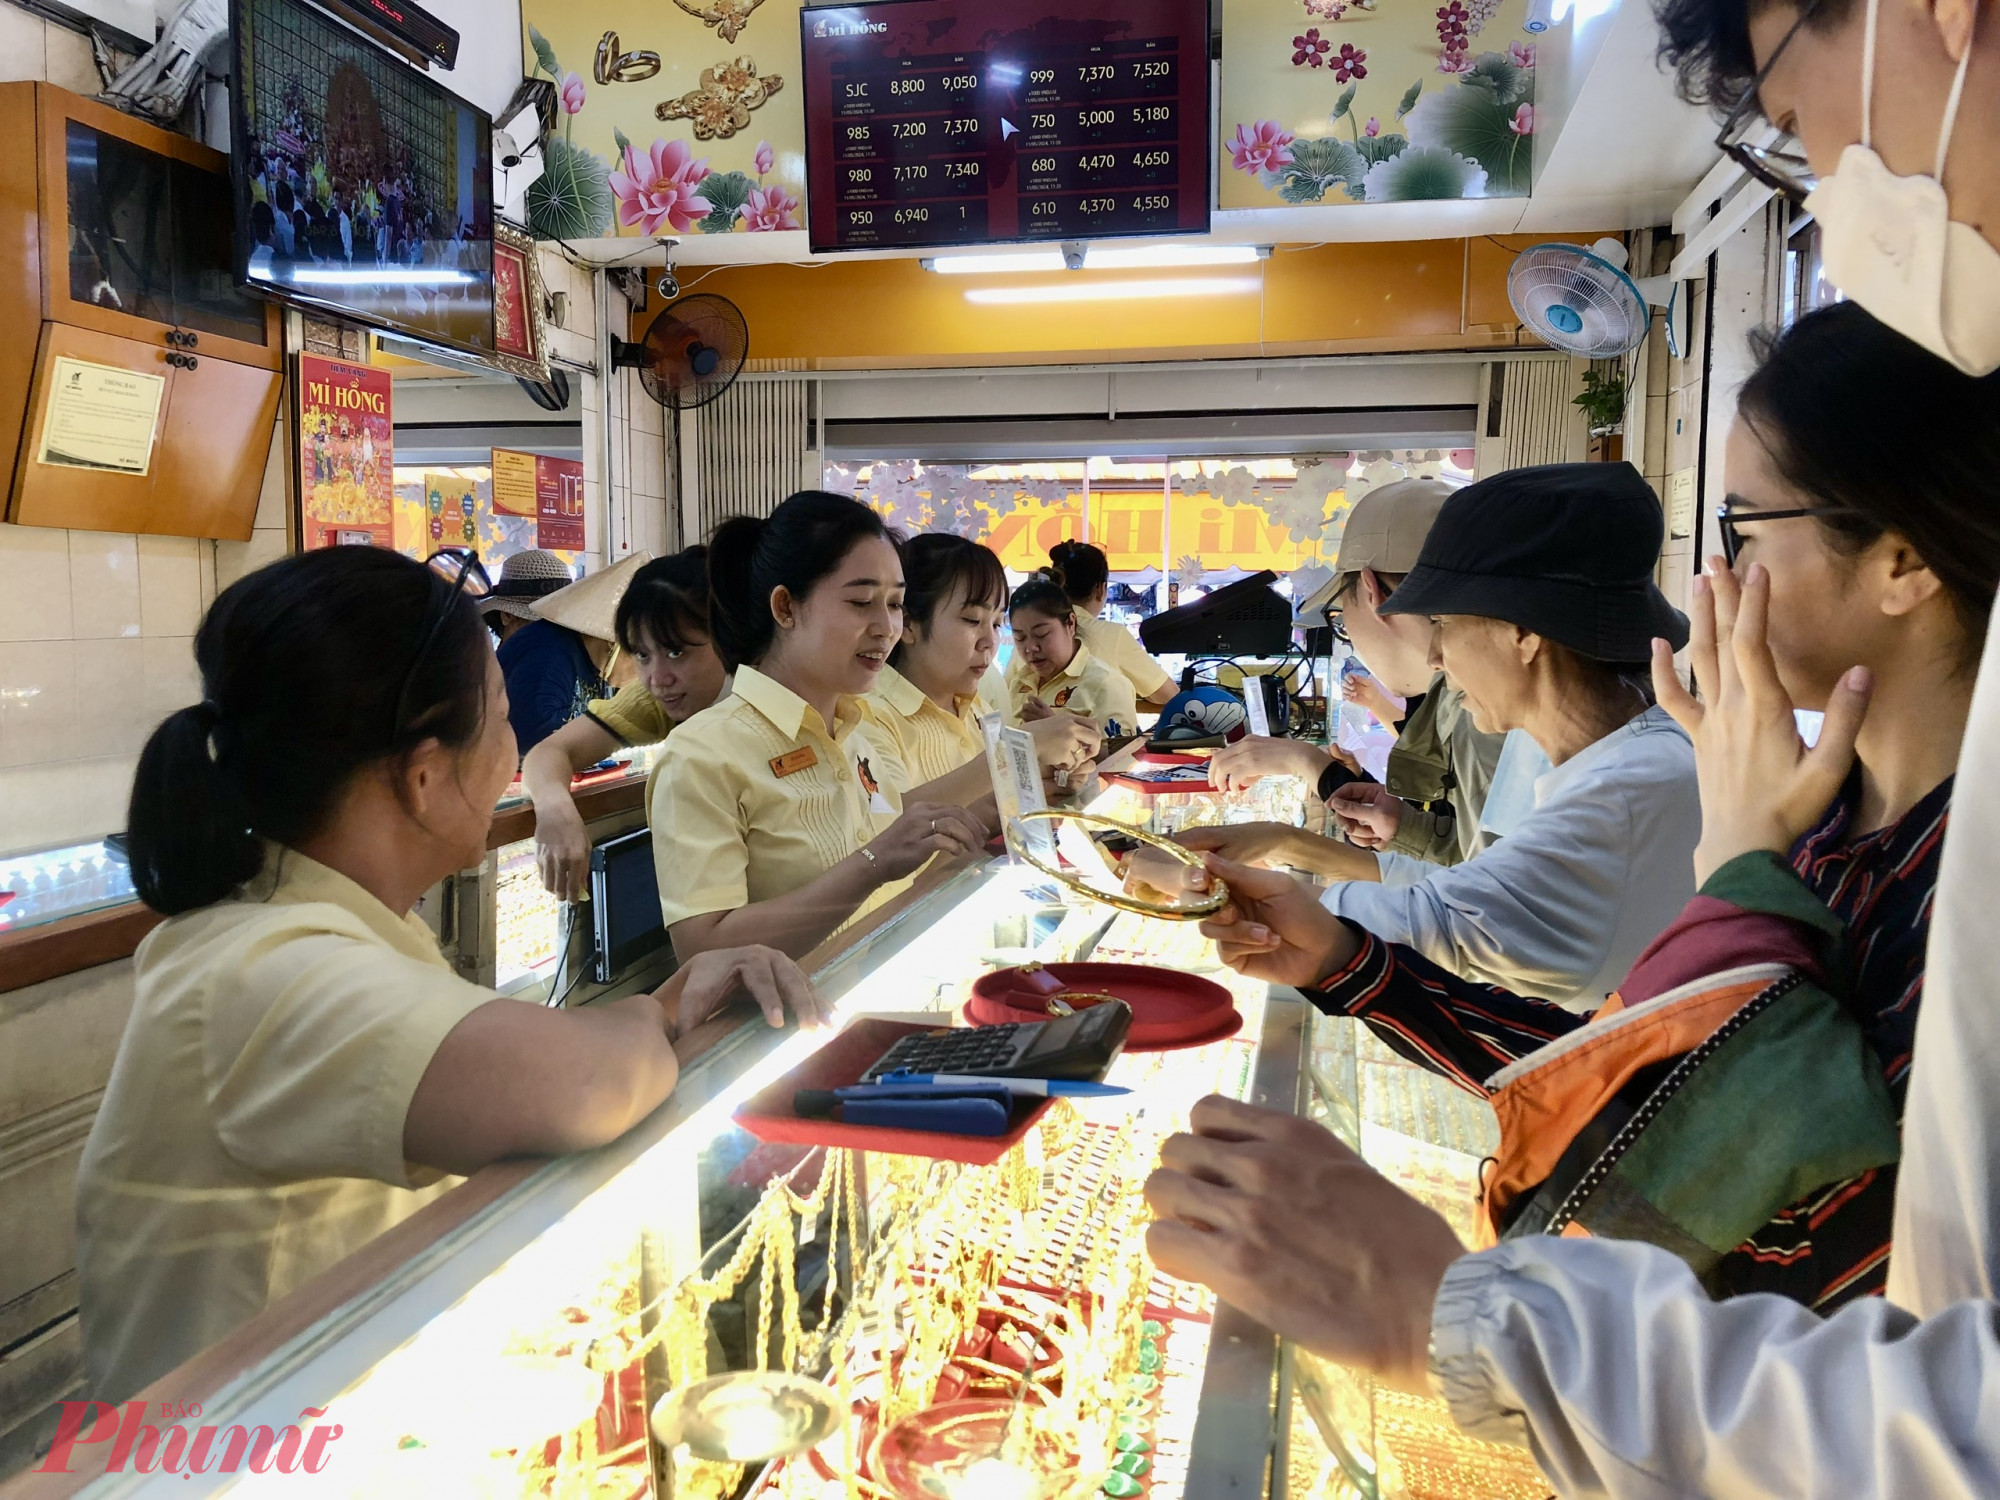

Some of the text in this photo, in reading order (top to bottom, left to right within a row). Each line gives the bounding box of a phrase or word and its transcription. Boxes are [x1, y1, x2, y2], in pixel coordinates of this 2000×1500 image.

[849, 18, 888, 35] HỒNG
[1030, 62, 1169, 84] 999 7,370 7,520
[846, 75, 977, 97] SJC 8,800 9,050
[1031, 107, 1170, 129] 750 5,000 5,180
[847, 119, 978, 140] 985 7,200 7,370
[848, 162, 979, 182] 980 7,170 7,340
[1031, 151, 1169, 172] 680 4,470 4,650
[850, 206, 965, 225] 950 6,940 1
[1032, 195, 1169, 215] 610 4,370 4,550
[335, 378, 385, 414] HỒNG
